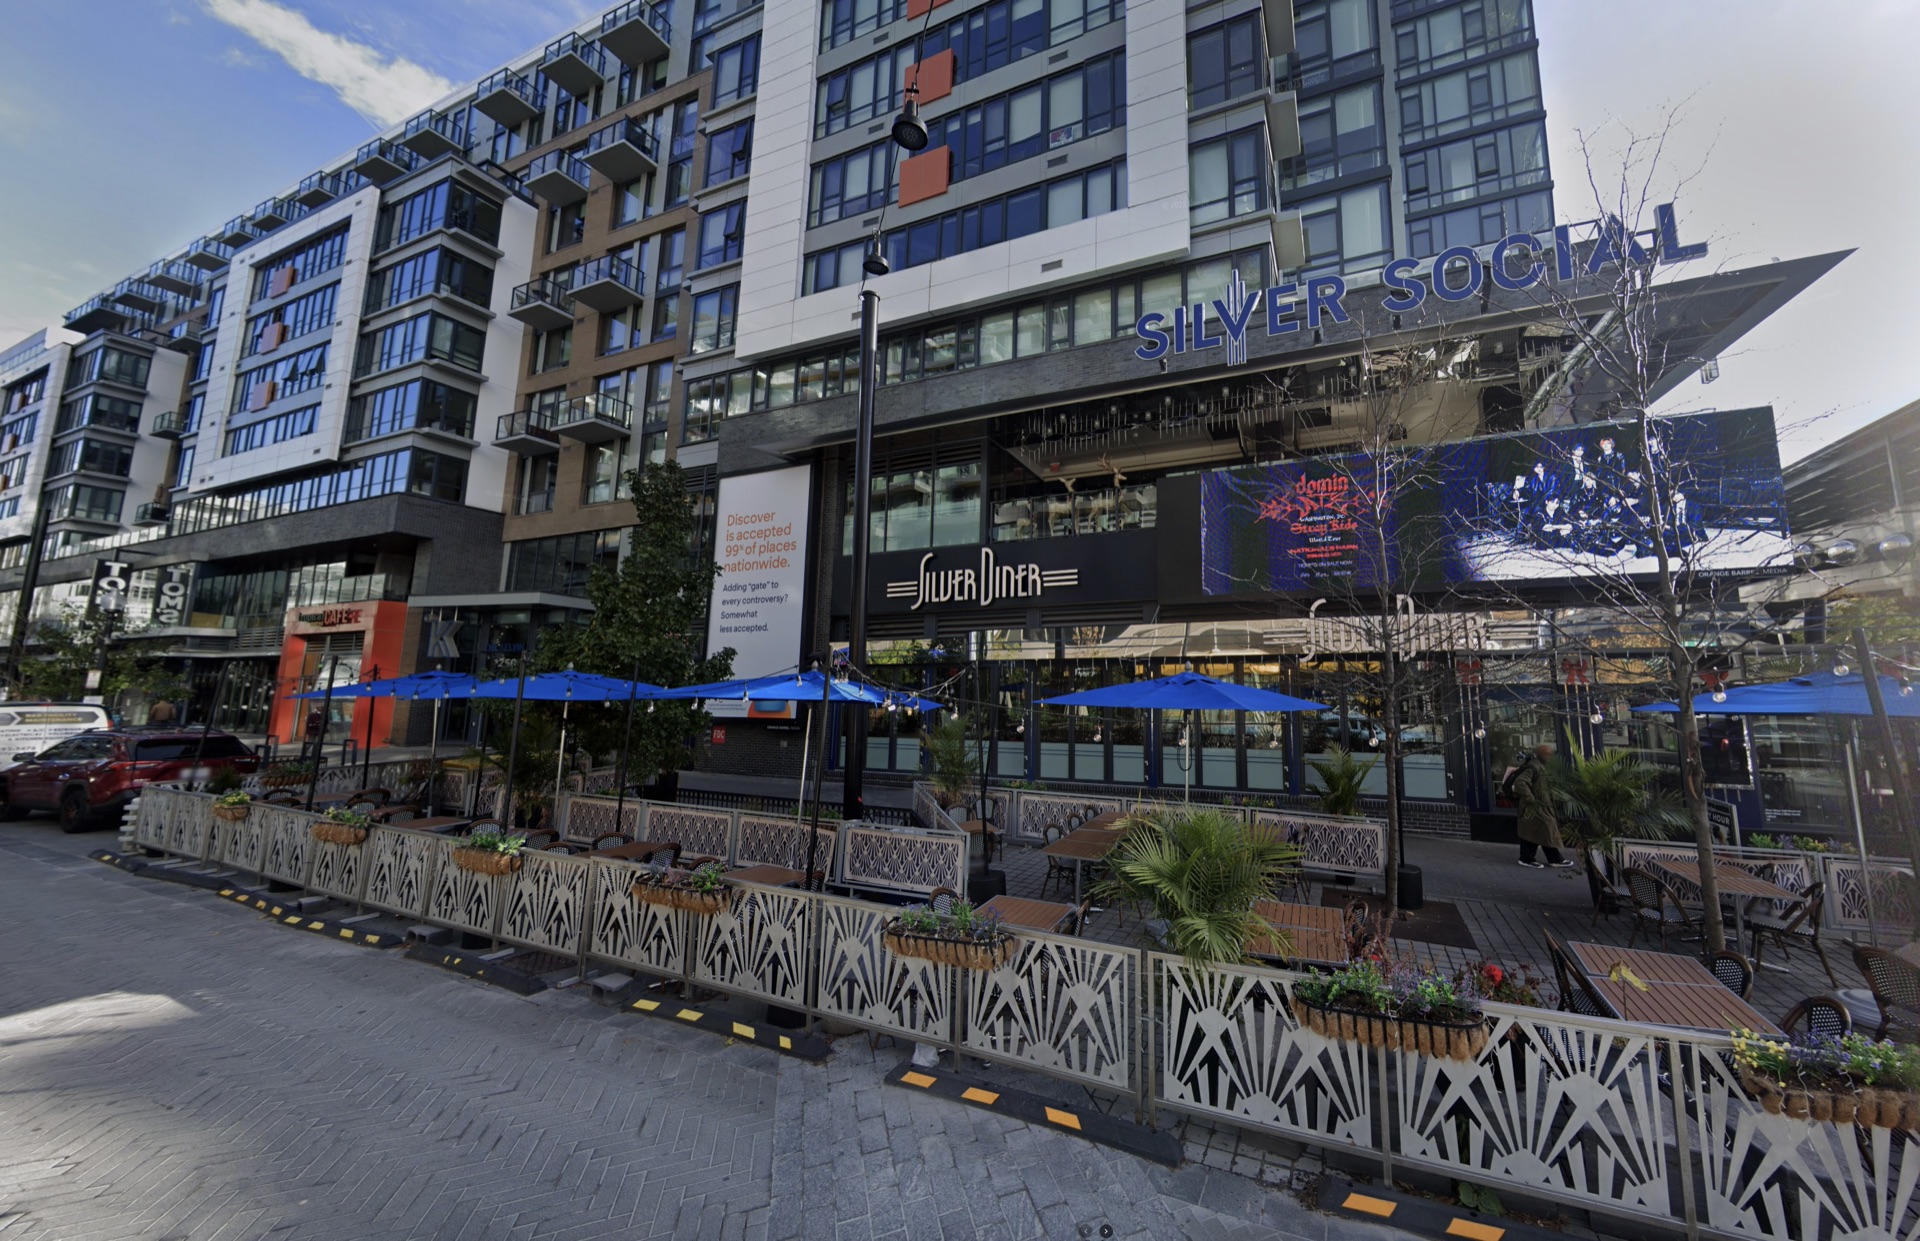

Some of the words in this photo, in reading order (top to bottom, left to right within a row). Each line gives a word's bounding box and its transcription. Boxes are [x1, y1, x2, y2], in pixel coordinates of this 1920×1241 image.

[1134, 269, 1350, 366] SILVER
[1381, 202, 1709, 312] SOCIAL
[727, 512, 776, 526] Discover
[726, 530, 735, 541] is
[736, 522, 792, 540] accepted
[745, 542, 757, 555] of
[758, 540, 797, 557] places
[723, 556, 790, 573] nationwide.
[723, 582, 747, 593] Adding
[748, 580, 770, 591] "gate"
[771, 581, 779, 589] to
[911, 552, 976, 610] SILVER
[721, 597, 741, 606] every
[741, 594, 788, 605] controversy?
[720, 610, 758, 620] Somewhat
[719, 624, 733, 633] less
[733, 623, 769, 634] accepted.
[1712, 813, 1730, 825] HOUR
